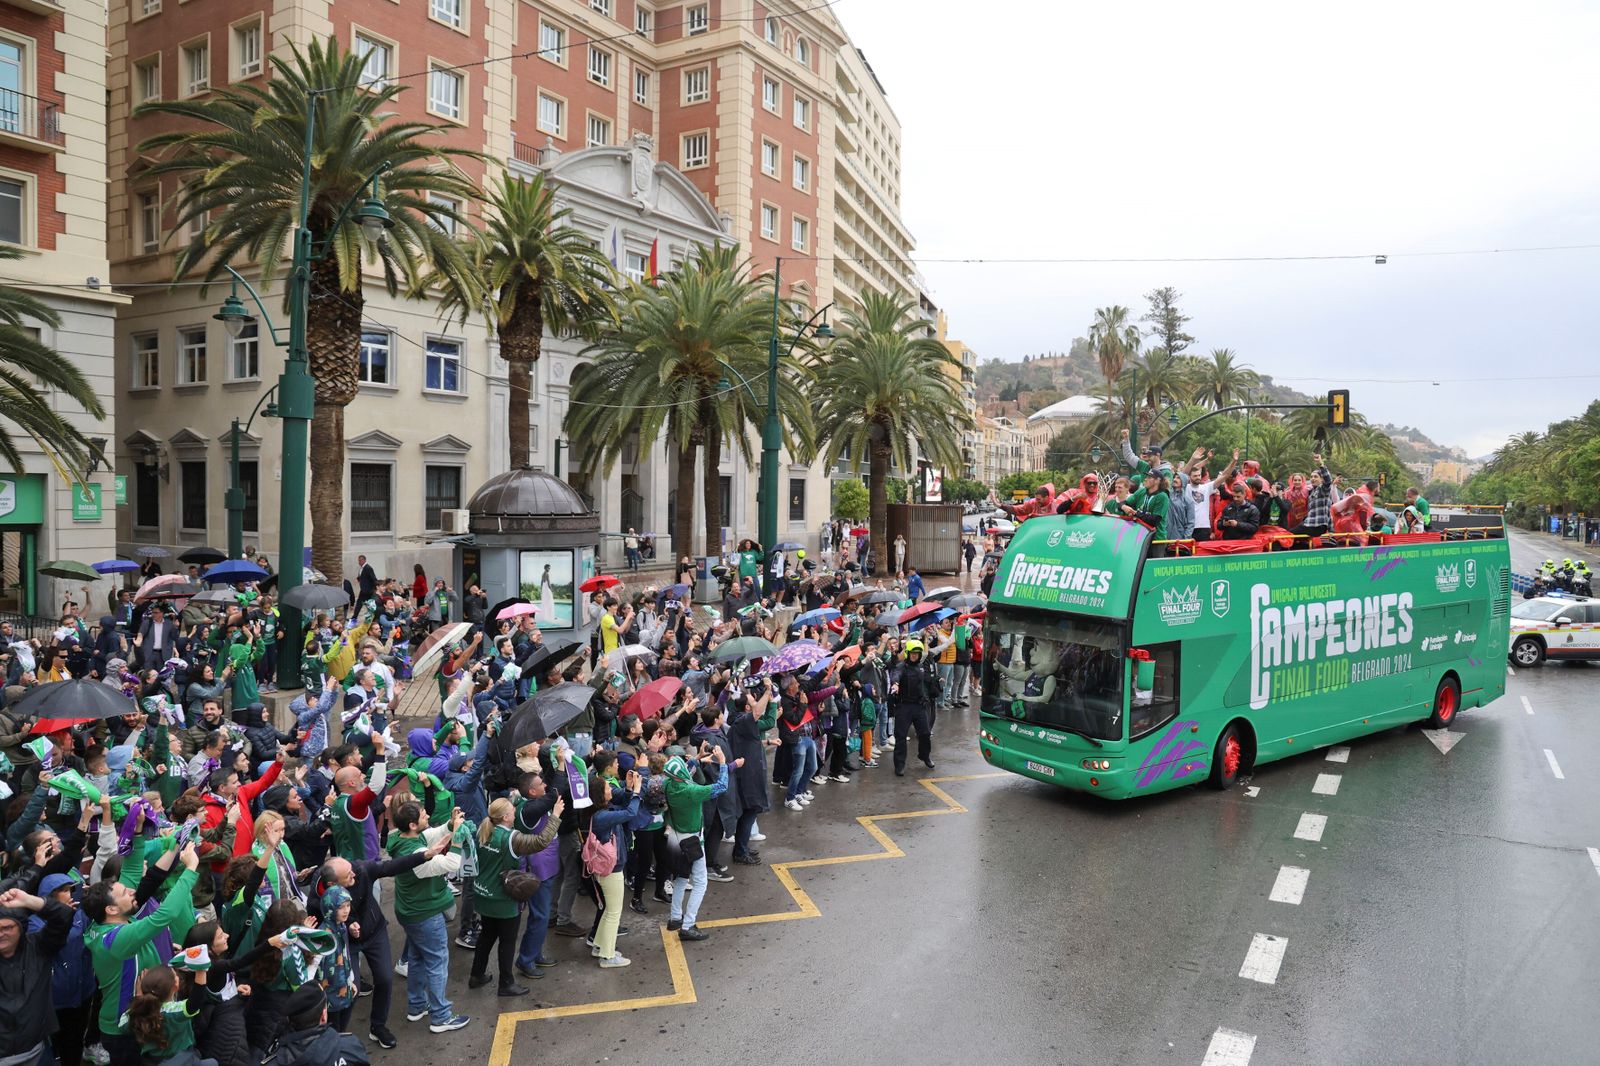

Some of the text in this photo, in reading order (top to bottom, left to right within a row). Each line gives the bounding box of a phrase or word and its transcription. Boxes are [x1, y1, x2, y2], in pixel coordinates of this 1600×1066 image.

[1004, 553, 1112, 598] CAMPEONES
[1014, 584, 1105, 608] FINAL FOUR BELGRADO 2024
[1161, 602, 1200, 614] FINAL FOUR
[1249, 583, 1414, 710] CAMPEONES
[1272, 653, 1413, 704] FINAL FOUR BELGRADO 2024
